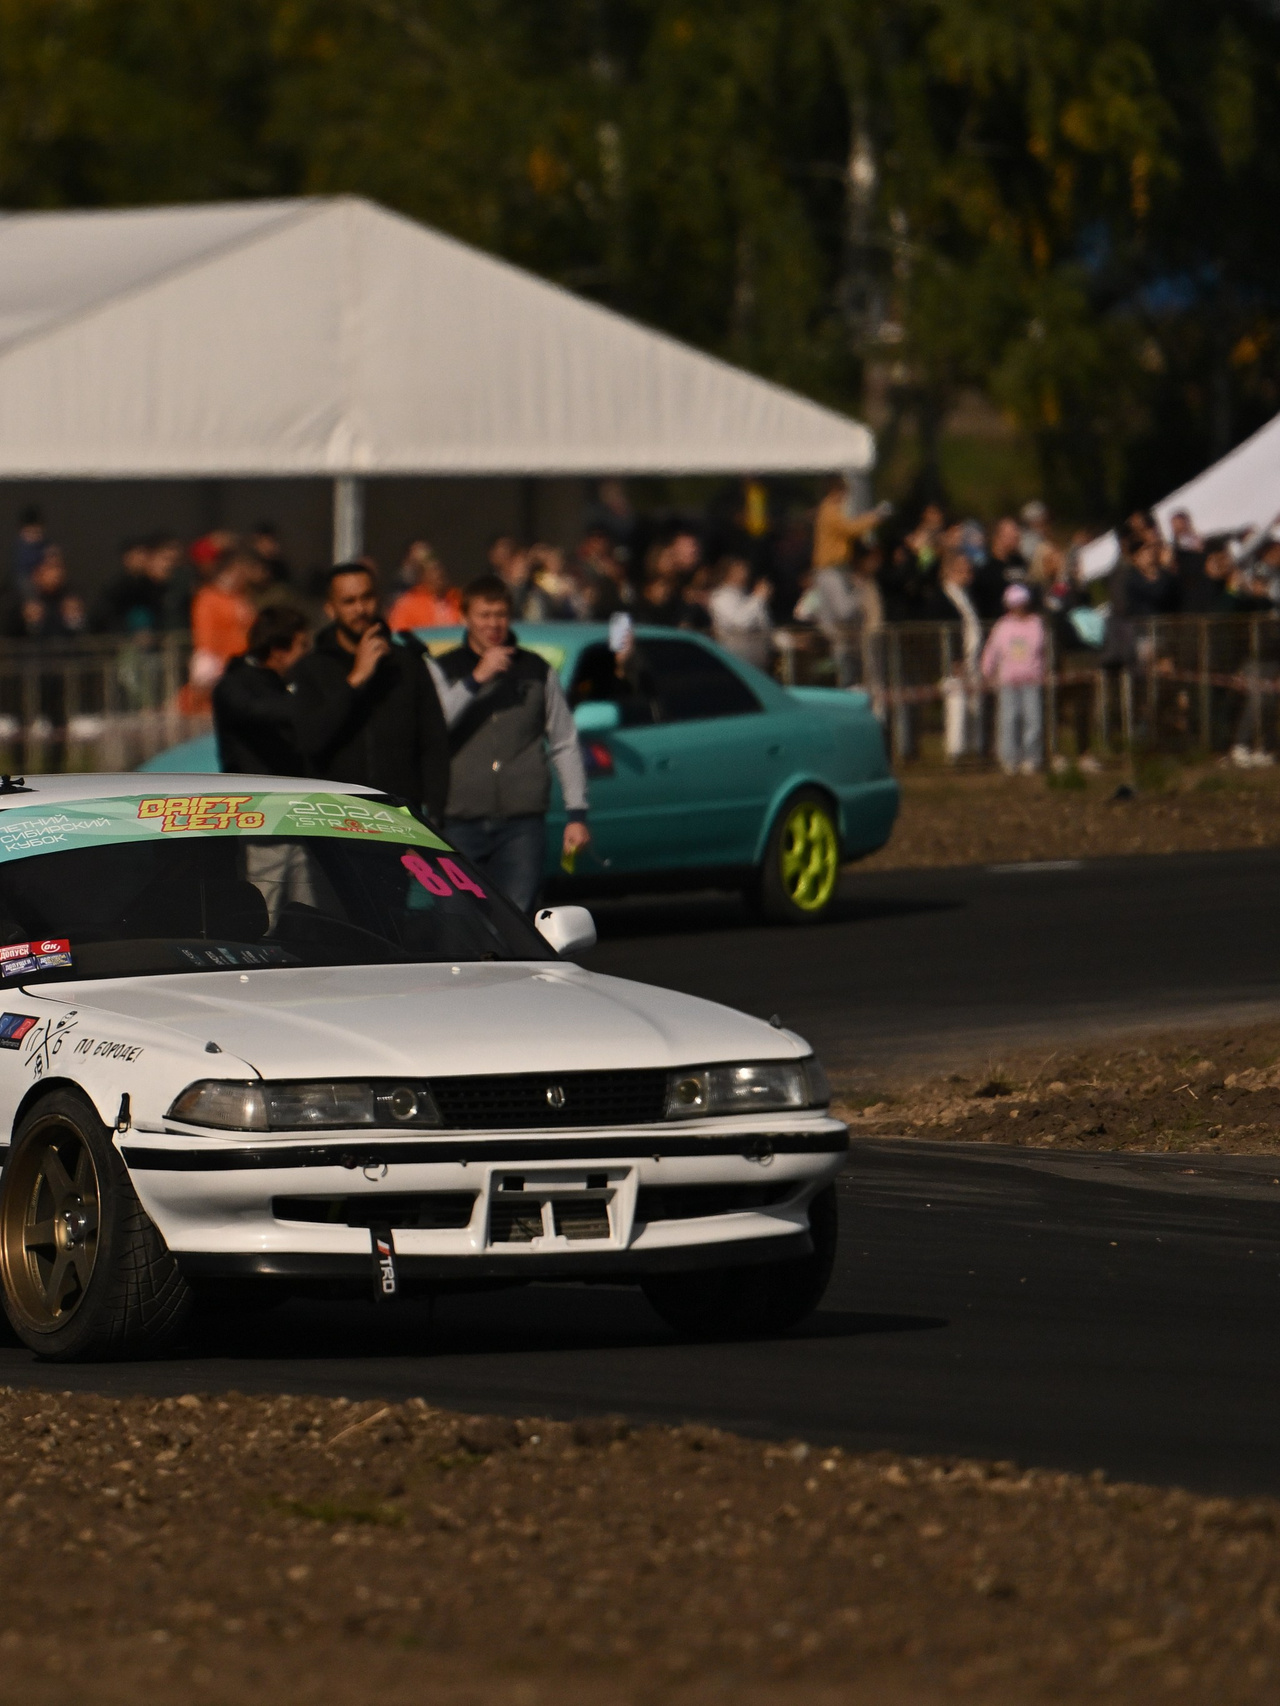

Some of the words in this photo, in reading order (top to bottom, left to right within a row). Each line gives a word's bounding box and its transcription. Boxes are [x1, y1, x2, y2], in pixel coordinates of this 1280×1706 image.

[137, 796, 253, 819] DRIFT
[288, 801, 395, 824] 2024
[0, 817, 112, 844] СИБИРСКИЙ
[161, 812, 265, 832] LETO
[5, 834, 69, 852] КУБОК
[400, 854, 487, 898] 84
[0, 948, 30, 961] ДОПУСК
[74, 1039, 95, 1055] ПО
[93, 1041, 144, 1062] БОРОДЕ!
[379, 1256, 396, 1293] TRD
